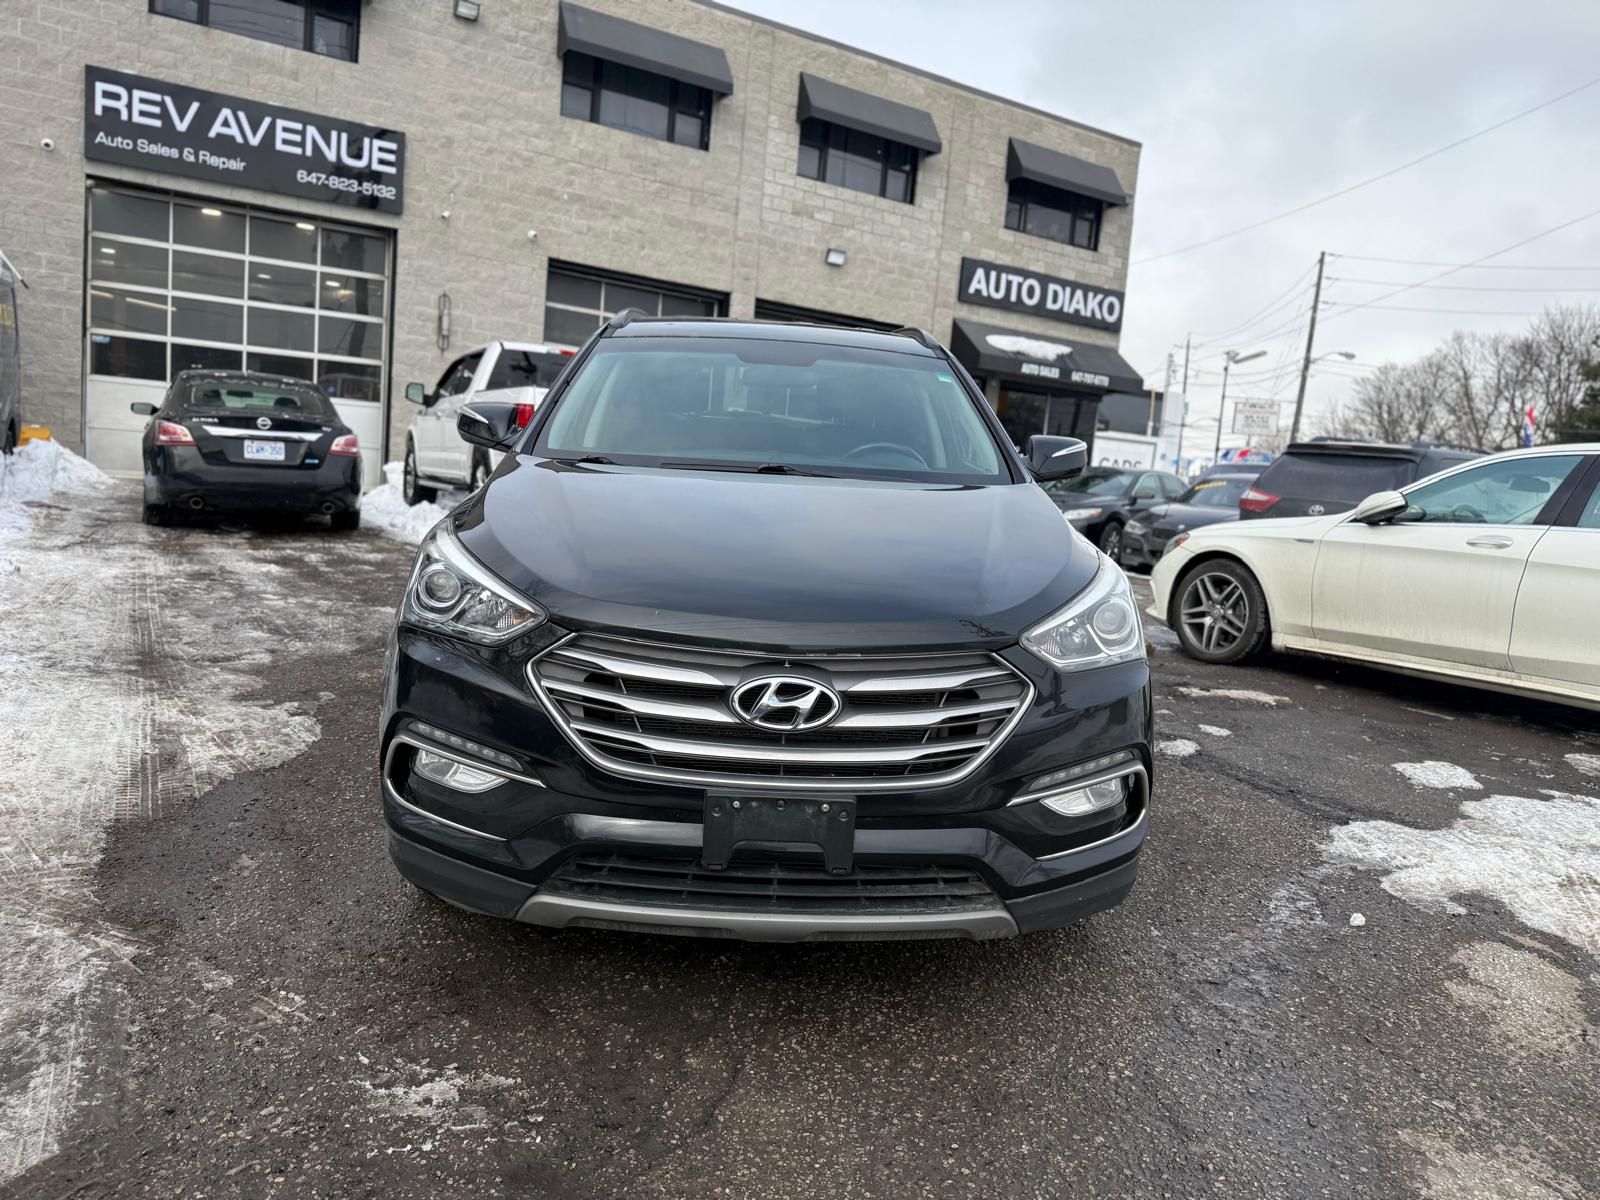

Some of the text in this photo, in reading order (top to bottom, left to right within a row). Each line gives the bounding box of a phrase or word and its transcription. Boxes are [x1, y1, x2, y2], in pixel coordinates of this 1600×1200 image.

[94, 81, 398, 175] REV AVENUE
[94, 131, 246, 171] Auto Sales & Repair
[297, 170, 396, 200] 647-823-5132
[968, 267, 1121, 323] AUTO DIAKO
[1021, 362, 1060, 379] AUTO SALES
